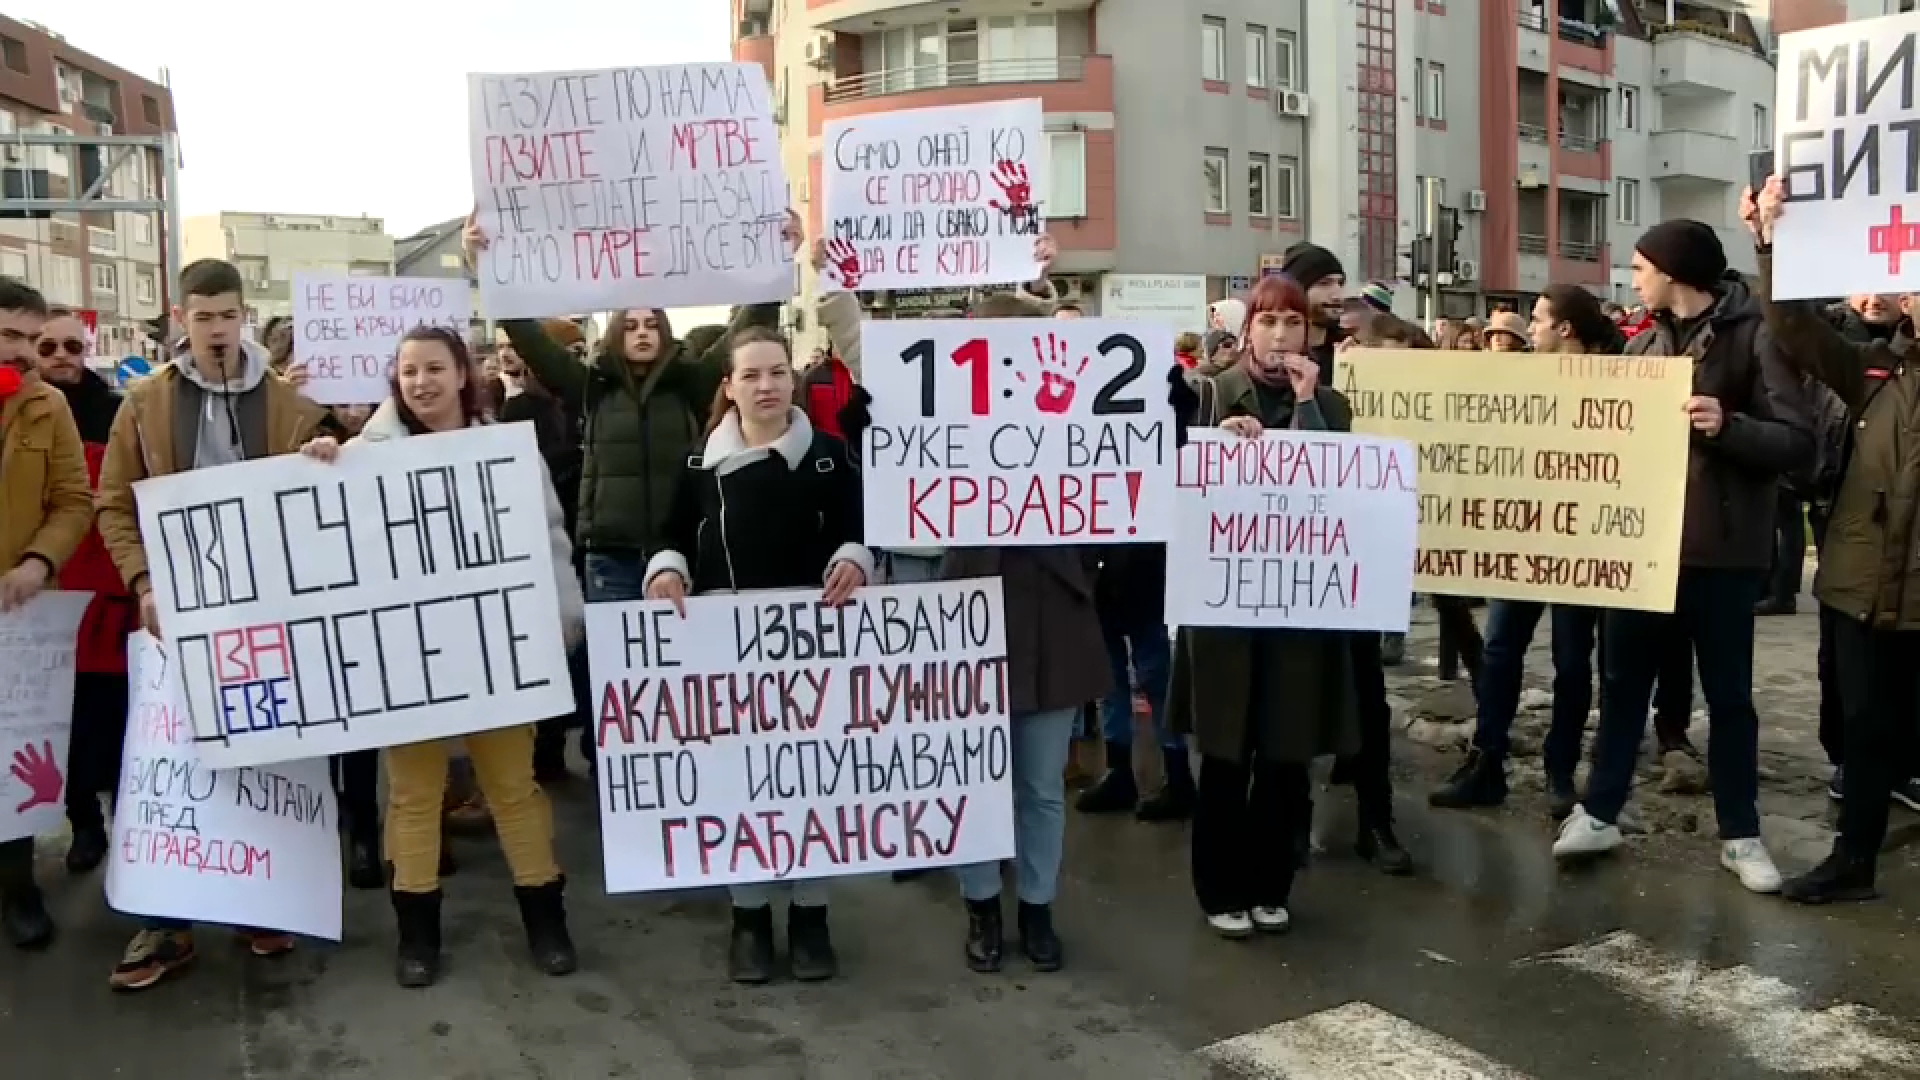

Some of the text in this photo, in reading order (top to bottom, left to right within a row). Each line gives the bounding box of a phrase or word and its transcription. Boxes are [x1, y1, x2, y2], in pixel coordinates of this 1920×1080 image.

[481, 67, 755, 128] ГАЗИТЕ ПО НАМА
[486, 118, 767, 184] ГАЗИТЕ И МРТВЕ
[918, 125, 969, 167] ОНАЈ
[990, 127, 1025, 164] КО
[866, 169, 981, 204] СЕ ПРОДАО
[834, 215, 893, 241] МИСЛИ
[902, 210, 926, 240] ДА
[936, 207, 989, 239] СВАКО
[492, 234, 562, 285] САМО
[573, 228, 654, 281] ПАРЕ
[863, 239, 990, 276] ДА СЕ КУПИ
[305, 283, 443, 311] НЕ БИ БИЛО
[305, 317, 349, 342] ОВЕ
[354, 315, 405, 339] КРВИ
[351, 353, 379, 379] ПО
[1413, 390, 1435, 423] СЕ
[1444, 391, 1558, 428] ПРЕВАРИЛИ
[870, 421, 1164, 470] РУКЕ СУ ВАМ
[907, 470, 1143, 540] КРВАВЕ!
[1260, 492, 1327, 515] ТО ЈЕ
[1461, 497, 1487, 530] НЕ
[1493, 497, 1543, 533] БОЈИ
[1552, 502, 1579, 536] СЕ
[158, 456, 531, 613] ОВО СУ НАШЕ
[1208, 511, 1351, 557] МИЛИНА
[1204, 556, 1360, 618] ЈЕДНА!
[620, 589, 991, 669] НЕ ИЗБЕГАВАМО
[597, 655, 1010, 749] АКАДЕМСКУ ДУЖНОСТ
[606, 725, 1008, 813] НЕГО ИСПУЊАВАМО
[138, 800, 201, 836] ПРЕД
[661, 794, 969, 878] ГРАЂАНСКУ
[122, 827, 271, 881] ЕПРАВДОМ
